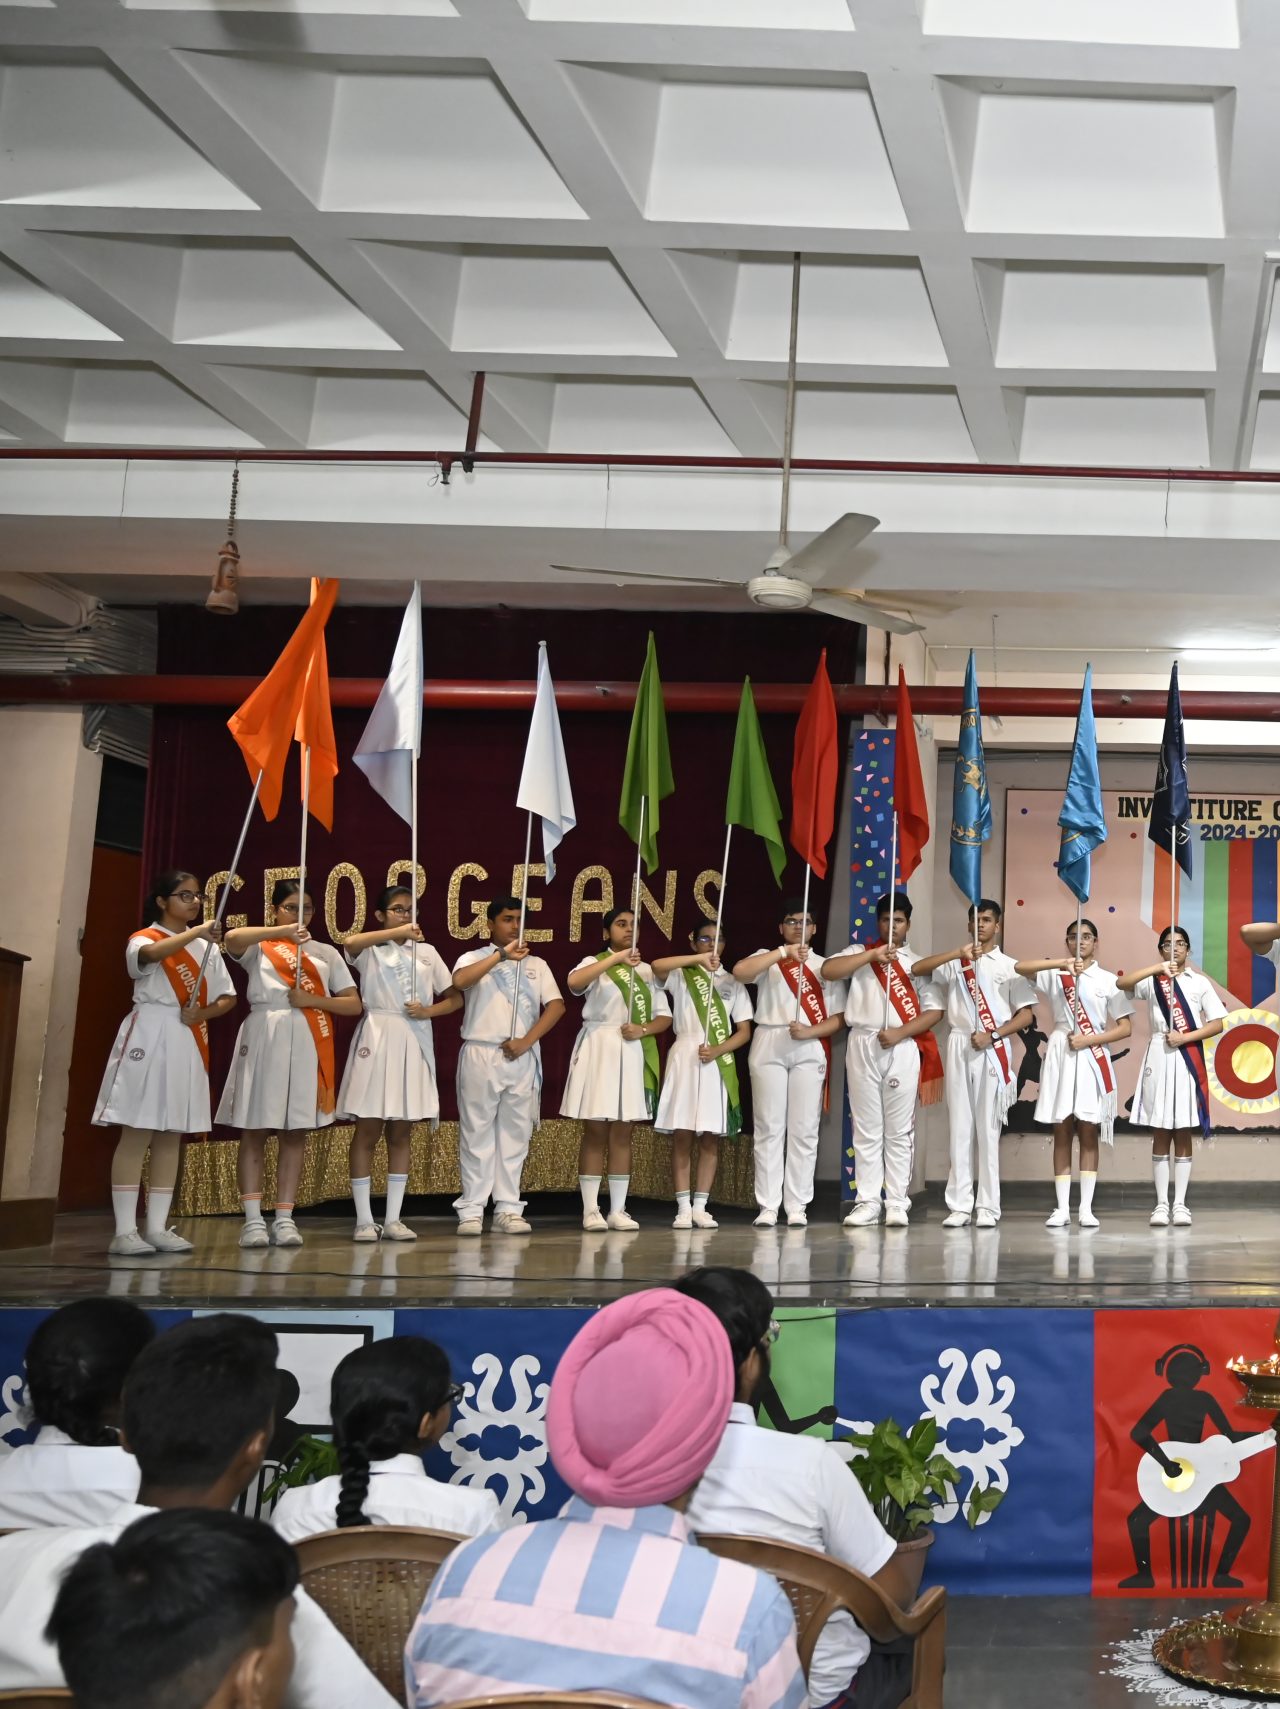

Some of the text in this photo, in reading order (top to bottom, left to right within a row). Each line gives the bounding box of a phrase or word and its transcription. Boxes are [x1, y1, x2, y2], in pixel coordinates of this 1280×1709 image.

[1117, 796, 1263, 822] INVITURE
[175, 963, 201, 1001] HOUS
[293, 968, 330, 1038] ICE-TAIN
[890, 976, 917, 1025] VICE-CAPT
[634, 993, 648, 1026] CAPTA
[806, 993, 824, 1025] CAPTA
[966, 978, 1003, 1050] SPTS CAPN
[1064, 985, 1104, 1060] SPTS CAIN
[1172, 1007, 1189, 1035] GIRL
[710, 1005, 734, 1066] VICE-CAIN
